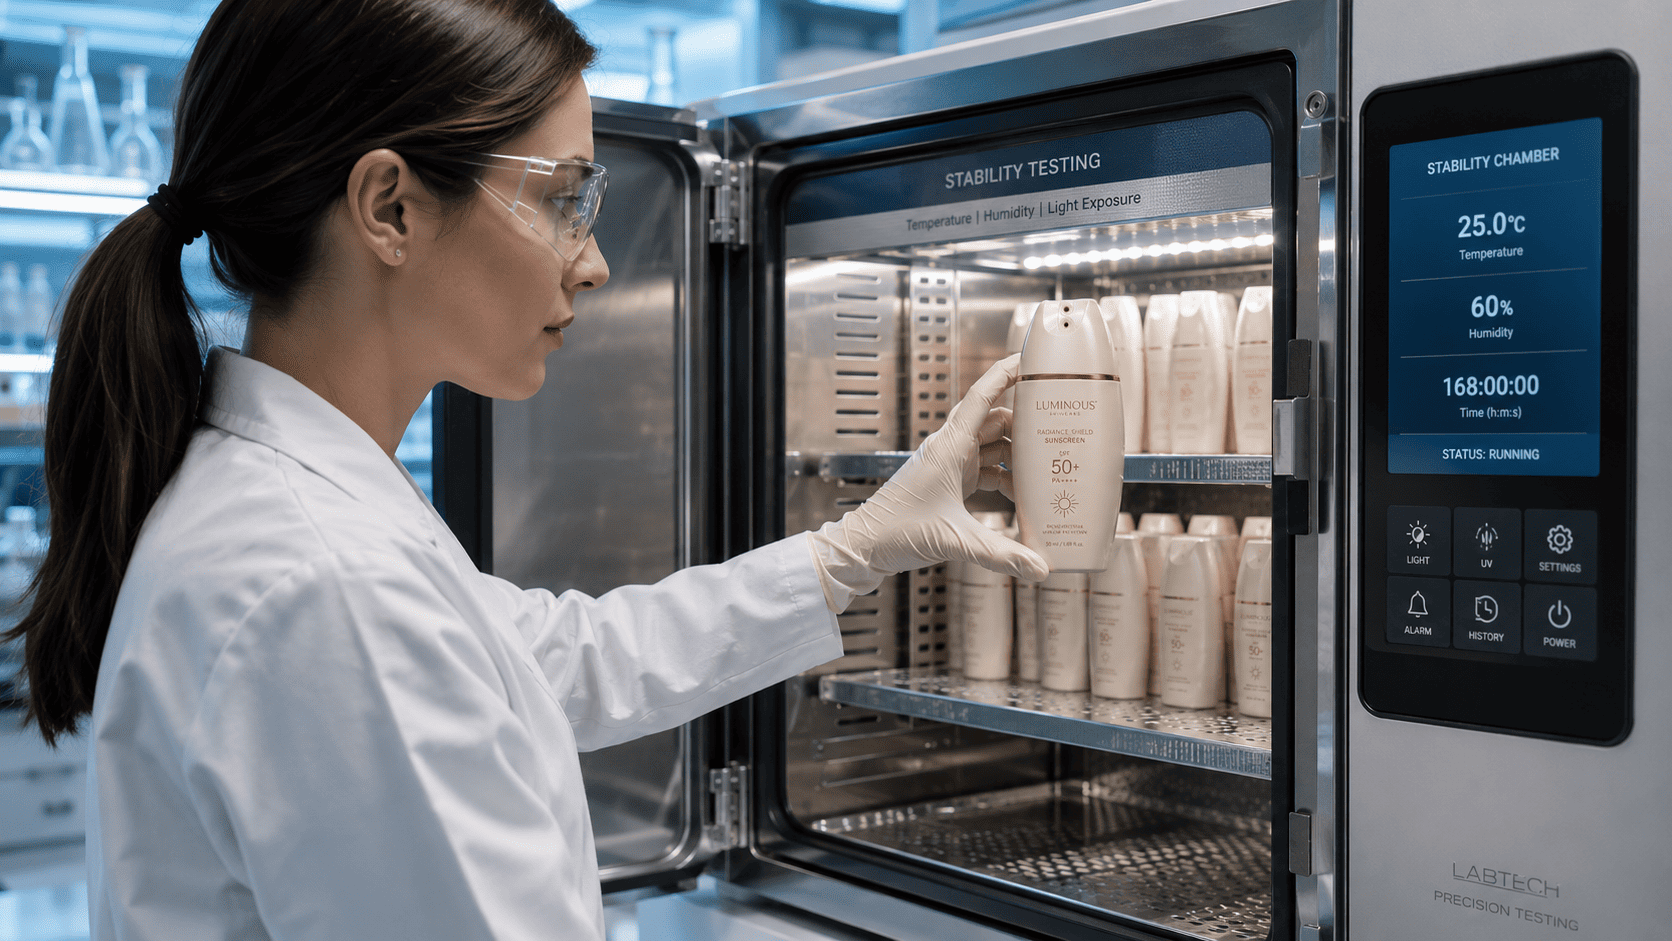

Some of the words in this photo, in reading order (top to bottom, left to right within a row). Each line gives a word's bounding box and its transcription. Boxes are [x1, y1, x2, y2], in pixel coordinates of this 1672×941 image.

[1427, 155, 1491, 175] STABILITY
[1494, 147, 1560, 167] CHAMBER
[945, 163, 1023, 189] STABILITY
[1028, 152, 1101, 177] TESTING
[906, 213, 972, 231] Temperature
[983, 205, 1035, 222] Humidity
[1048, 199, 1079, 216] Light
[1082, 193, 1142, 211] Exposure
[1458, 211, 1526, 238] 25.0°C
[1459, 247, 1524, 261] Temperature
[1471, 294, 1514, 318] 60%
[1469, 327, 1514, 340] Humidity
[1443, 374, 1540, 396] 168:00:00
[1459, 407, 1485, 418] Time
[1486, 406, 1522, 419] (h:m:s)
[1442, 449, 1486, 460] STATUS:
[1489, 449, 1540, 460] RUNNING
[1051, 459, 1080, 475] 50+
[1406, 556, 1430, 565] LIGHT
[1480, 559, 1493, 568] UV
[1539, 562, 1581, 573] SETTINGS
[1404, 625, 1432, 635] ALARM
[1468, 631, 1504, 642] HISTORY
[1543, 637, 1576, 648] POWER
[1452, 861, 1560, 898] LABTECH
[1434, 890, 1510, 916] PRECISION
[1515, 907, 1579, 931] TESTING
